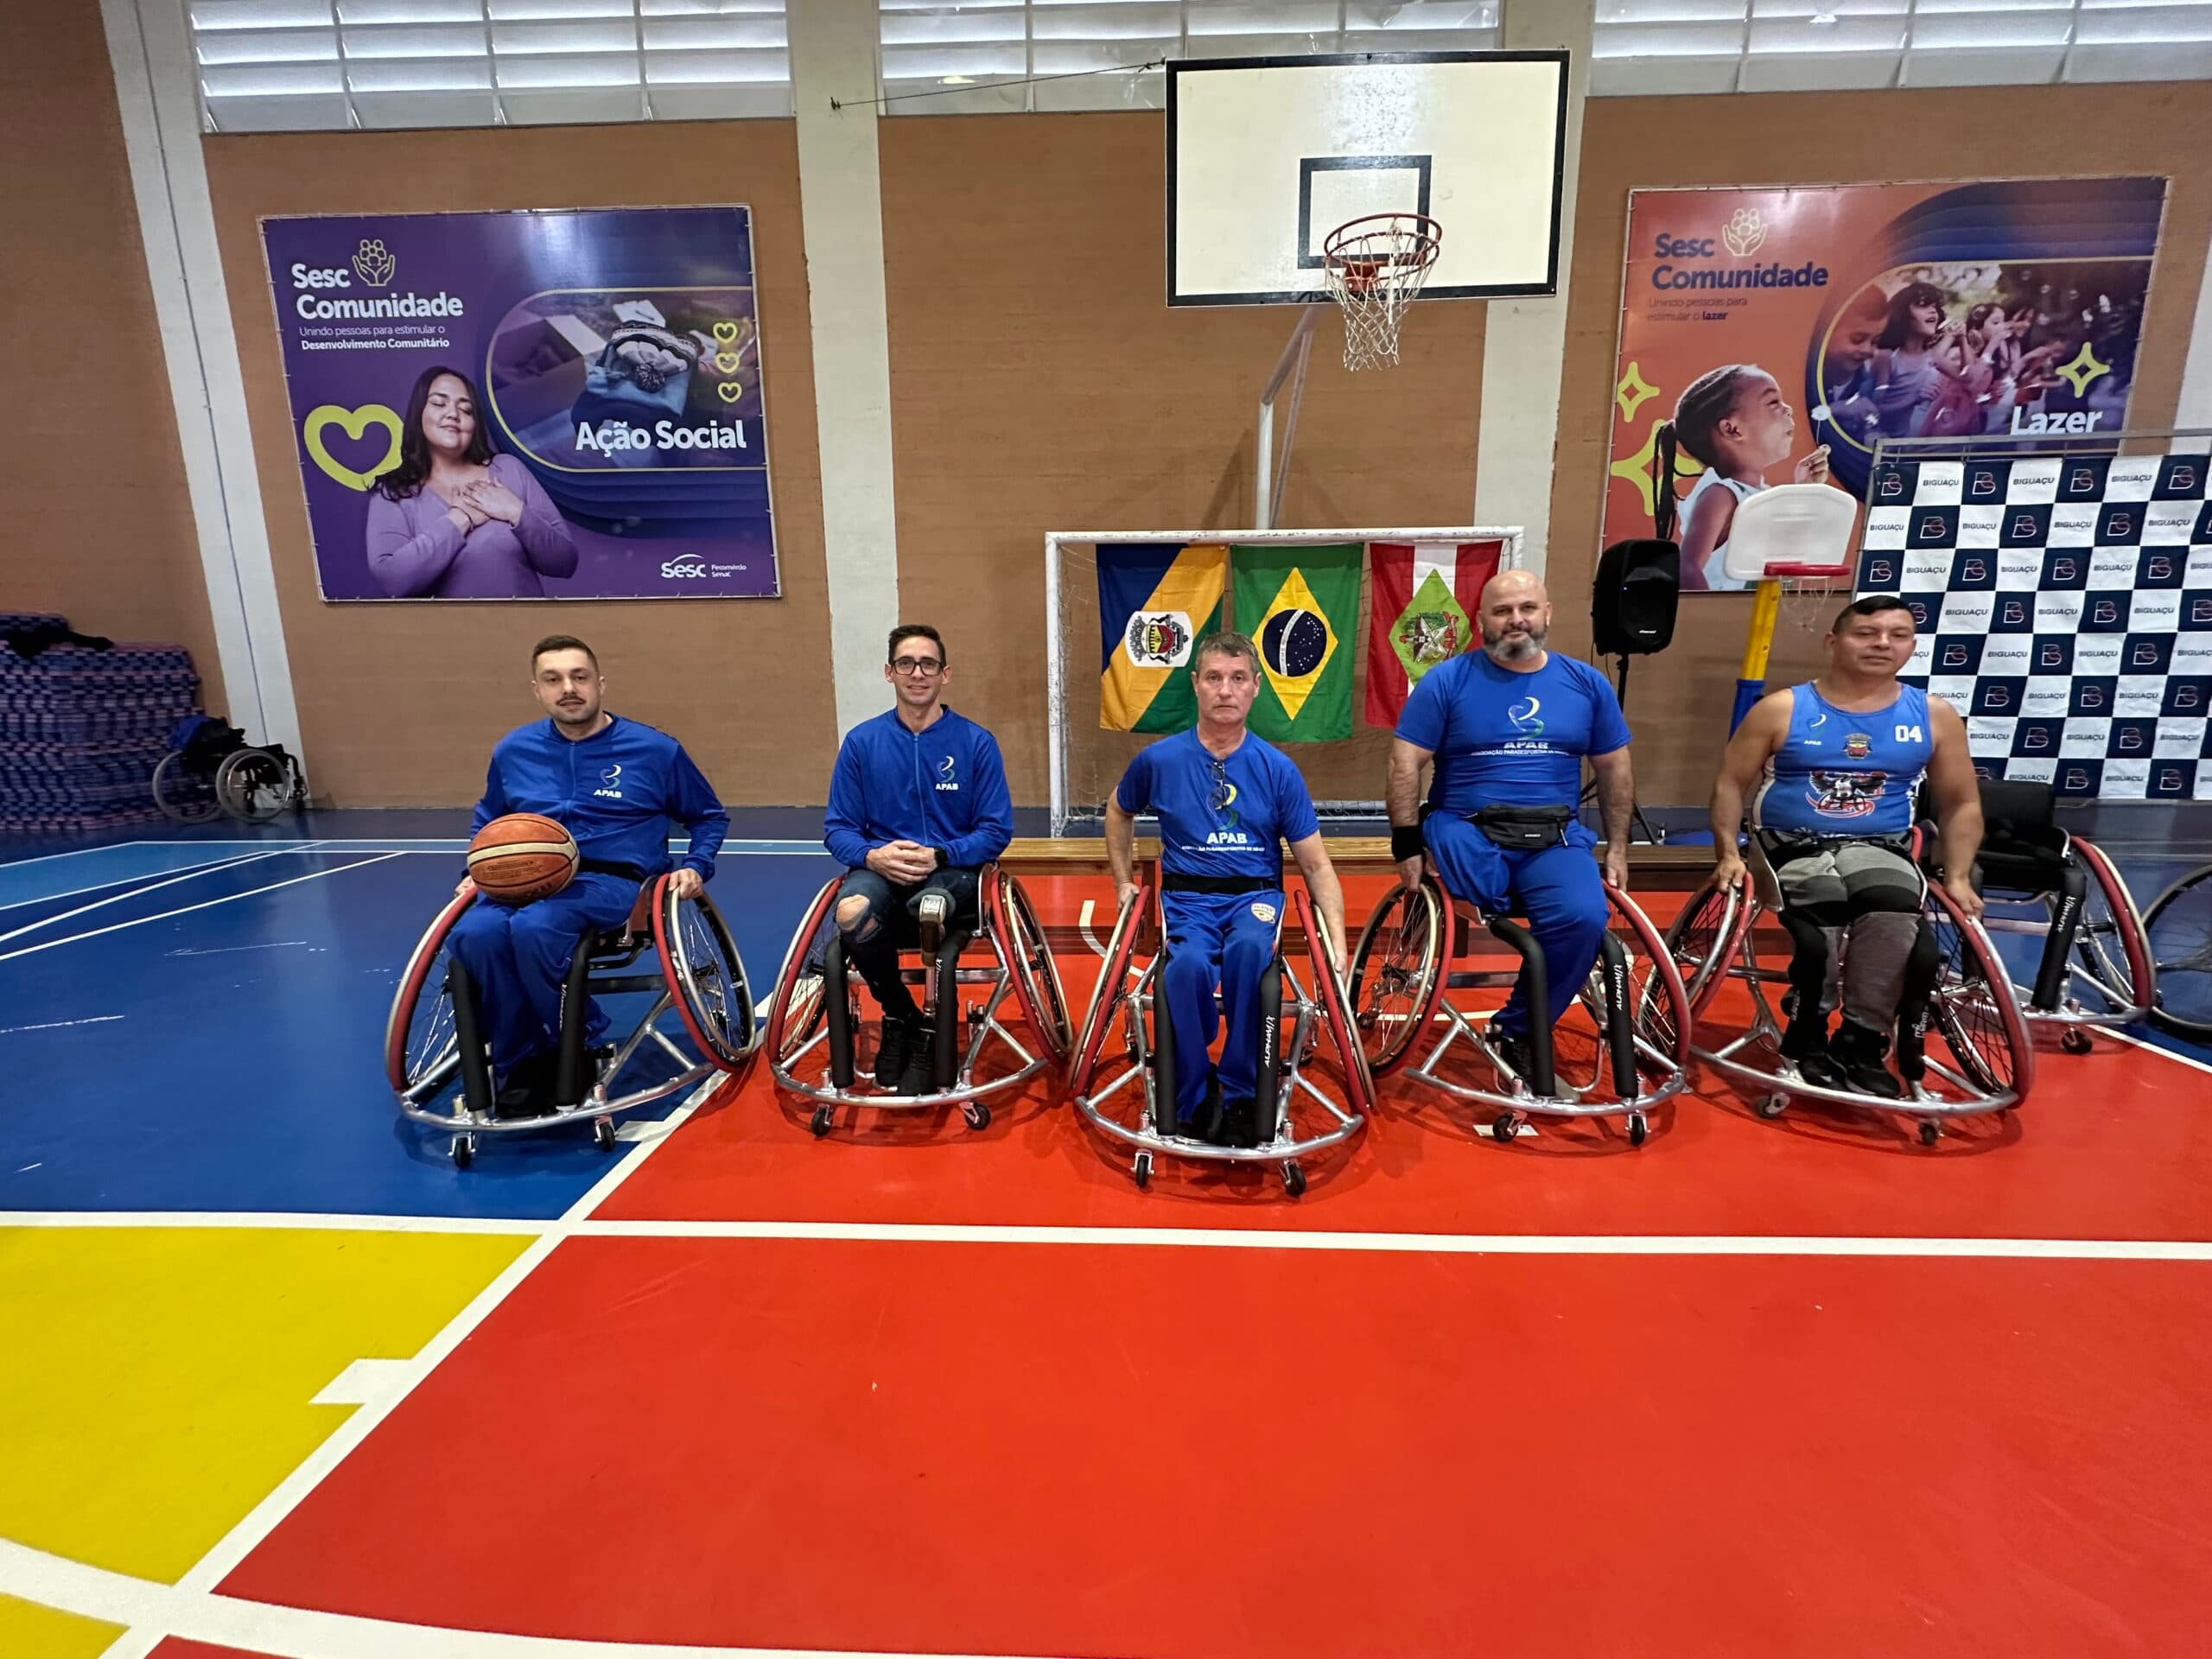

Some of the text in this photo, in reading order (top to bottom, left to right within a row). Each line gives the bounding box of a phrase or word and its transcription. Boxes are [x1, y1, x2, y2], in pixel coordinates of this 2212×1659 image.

[1654, 232, 1715, 258] Sesc
[291, 263, 352, 289] Sesc
[1651, 262, 1829, 290] Comunidade
[296, 291, 464, 320] Comunidade
[1649, 297, 1748, 308] Unindo pessoas para
[1647, 312, 1690, 321] estimular
[1702, 311, 1728, 321] lazer
[299, 327, 334, 336] Unindo
[335, 327, 372, 337] pessoas
[373, 327, 393, 336] para
[395, 325, 436, 334] estimular
[301, 338, 450, 350] Desenvolvimento Comunitário
[2010, 405, 2103, 435] Lazer
[575, 420, 747, 458] Ação Social
[2013, 477, 2055, 486] BIGUAÇU
[661, 562, 707, 578] Sesc
[1895, 725, 1923, 742] 04
[594, 789, 622, 798] APAB
[1206, 832, 1249, 844] APAB
